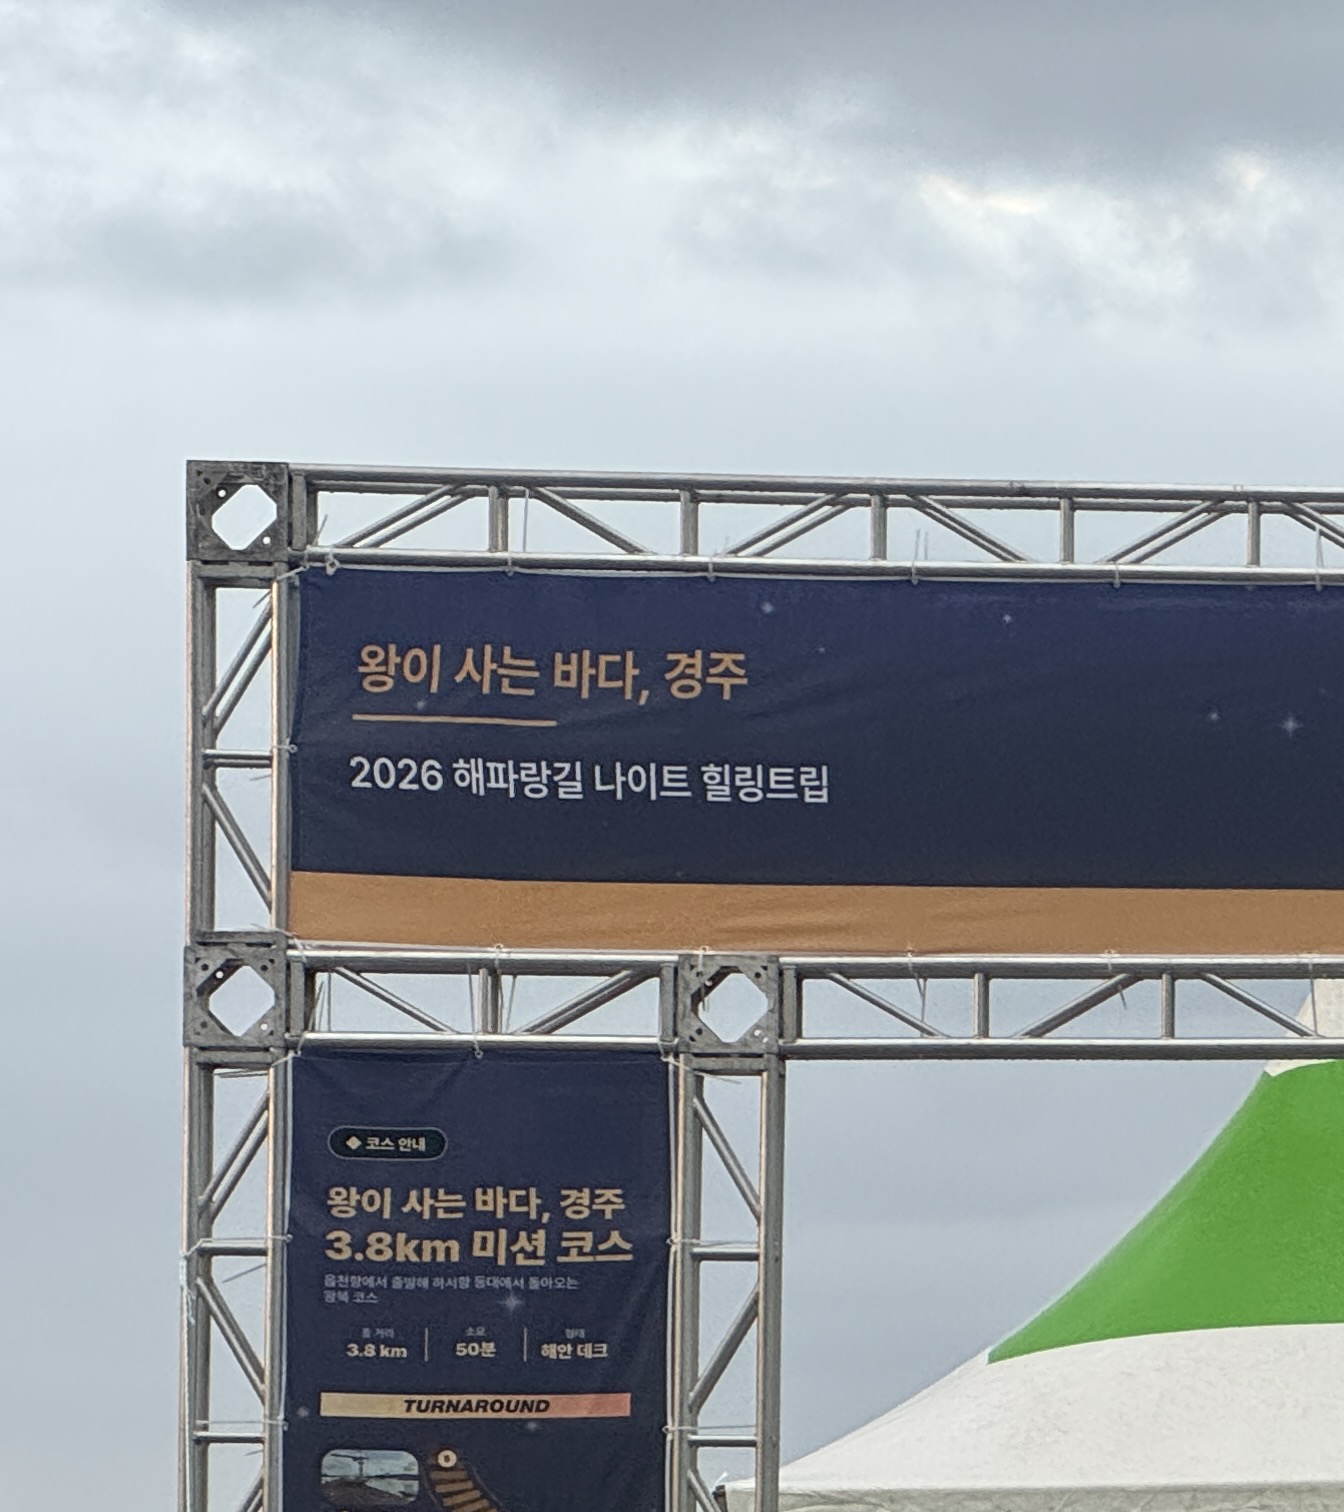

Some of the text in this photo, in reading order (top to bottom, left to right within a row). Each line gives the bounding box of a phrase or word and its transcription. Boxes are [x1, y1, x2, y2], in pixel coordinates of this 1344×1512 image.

[358, 644, 748, 705] 왕이 사는 바다, 경주
[350, 756, 829, 803] 2026 해파랑길 나이트 힐링트립
[366, 1137, 426, 1152] 코스 안내
[326, 1186, 626, 1223] 왕이 사는 바다, 경주
[324, 1228, 634, 1266] 3.8km 미션 코스
[346, 1343, 408, 1358] 3.8 km
[455, 1342, 497, 1358] 50분
[403, 1399, 551, 1415] TURNAROUND
